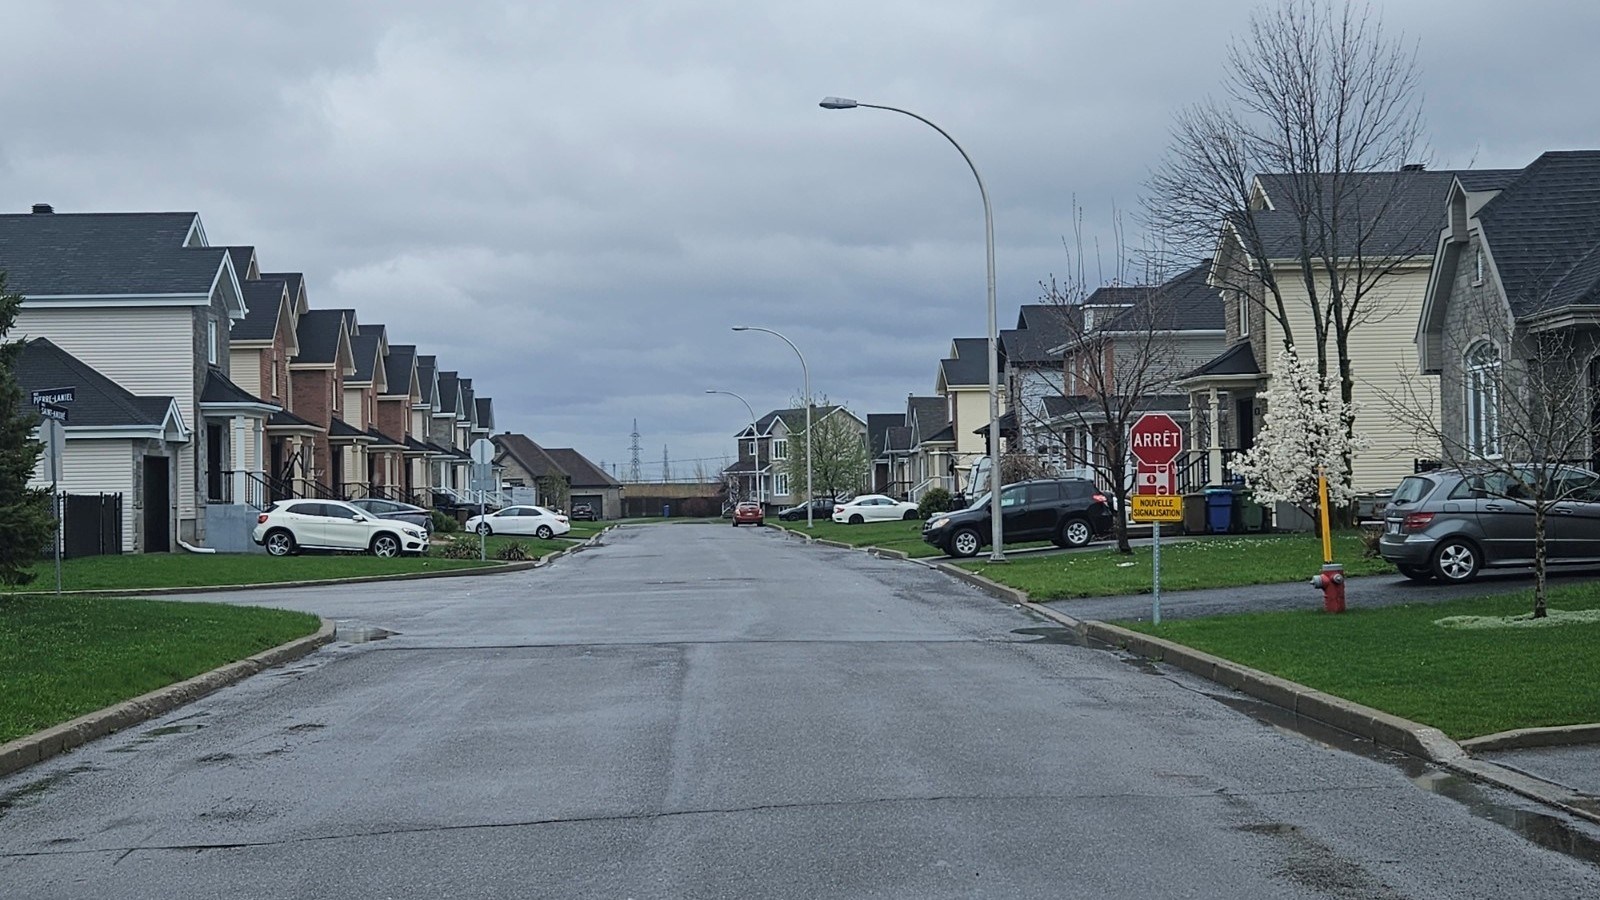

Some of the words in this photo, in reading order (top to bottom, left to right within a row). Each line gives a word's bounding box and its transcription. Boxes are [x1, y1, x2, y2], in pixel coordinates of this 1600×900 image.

[1133, 430, 1179, 447] ARRÊT
[1140, 499, 1174, 507] NOUVELLE
[1133, 509, 1180, 517] SIGNALISATION
